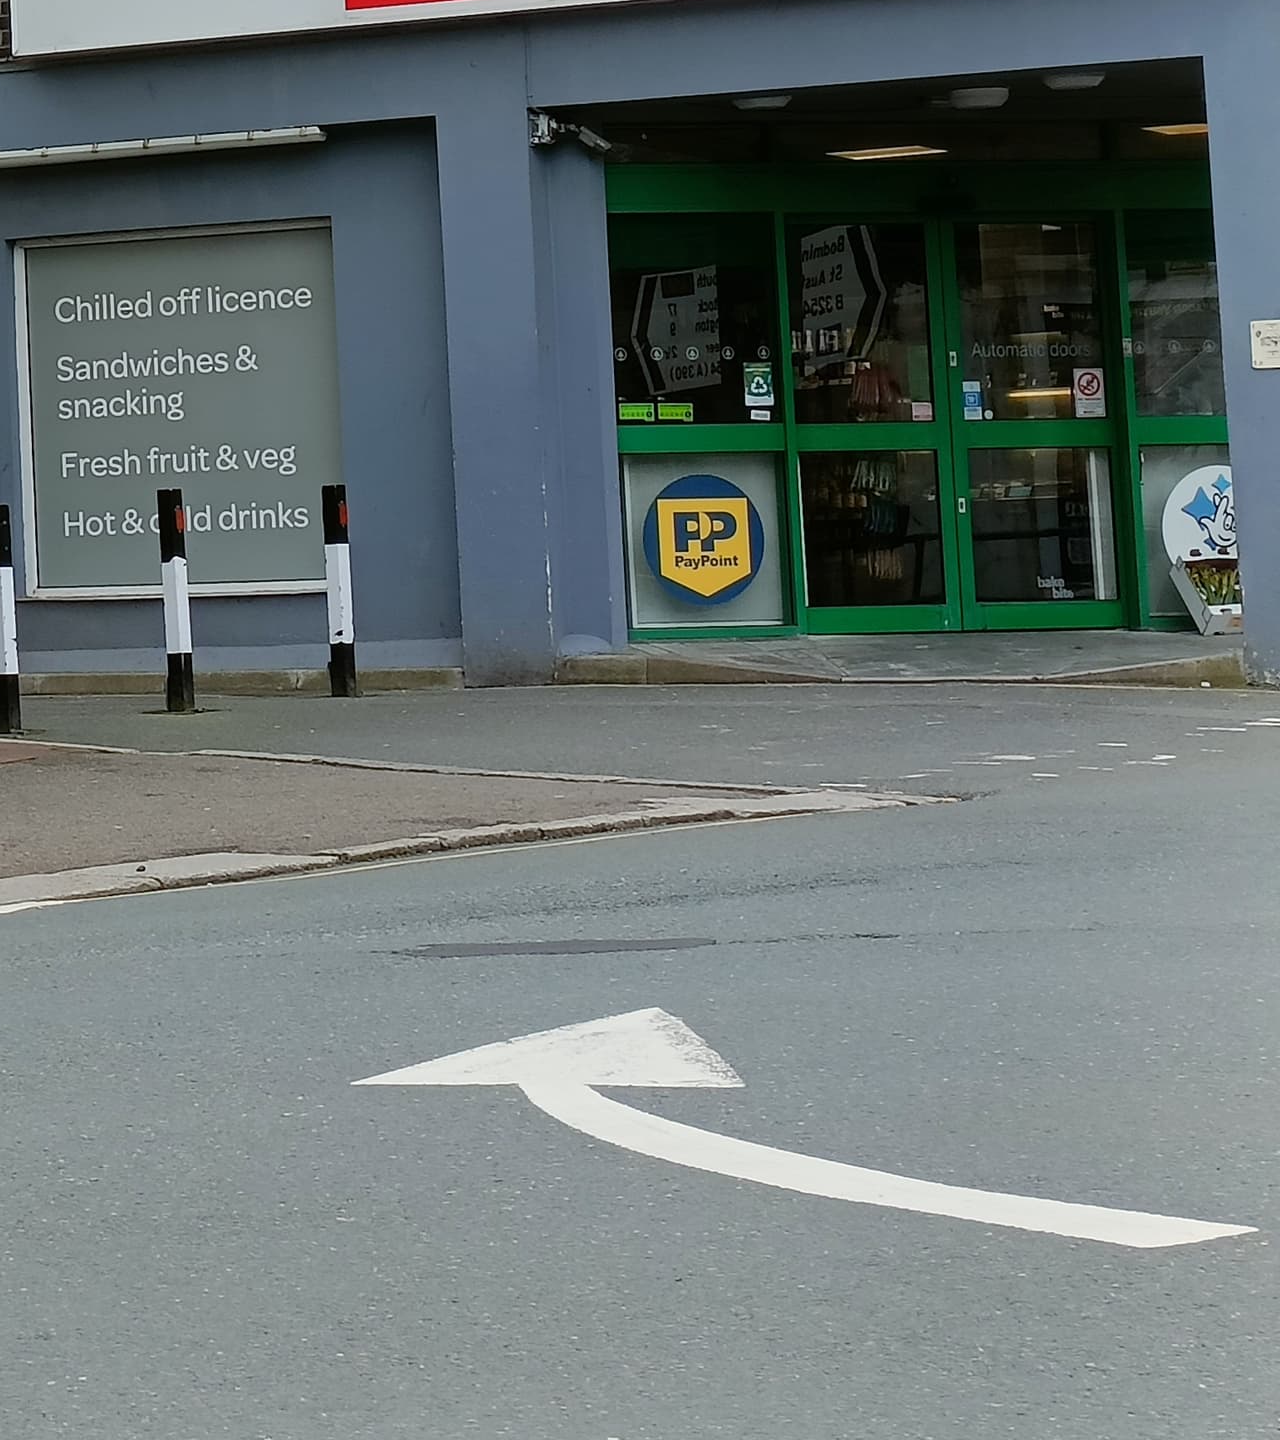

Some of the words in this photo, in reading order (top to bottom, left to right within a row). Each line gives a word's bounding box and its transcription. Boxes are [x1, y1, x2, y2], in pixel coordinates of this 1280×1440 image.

[54, 291, 153, 323] Chilled
[159, 287, 201, 317] off
[207, 285, 312, 313] licence
[56, 348, 229, 382] Sandwiches
[235, 345, 259, 371] &
[971, 342, 1047, 358] Automatic
[1049, 343, 1090, 357] doors
[58, 388, 184, 420] snacking
[60, 449, 140, 479] Fresh
[146, 445, 210, 475] fruit
[216, 444, 239, 472] &
[243, 445, 297, 475] veg
[63, 510, 116, 537] Hot
[122, 509, 144, 535] &
[149, 505, 211, 533] cld
[218, 501, 309, 532] drinks
[675, 555, 739, 570] PayPoint
